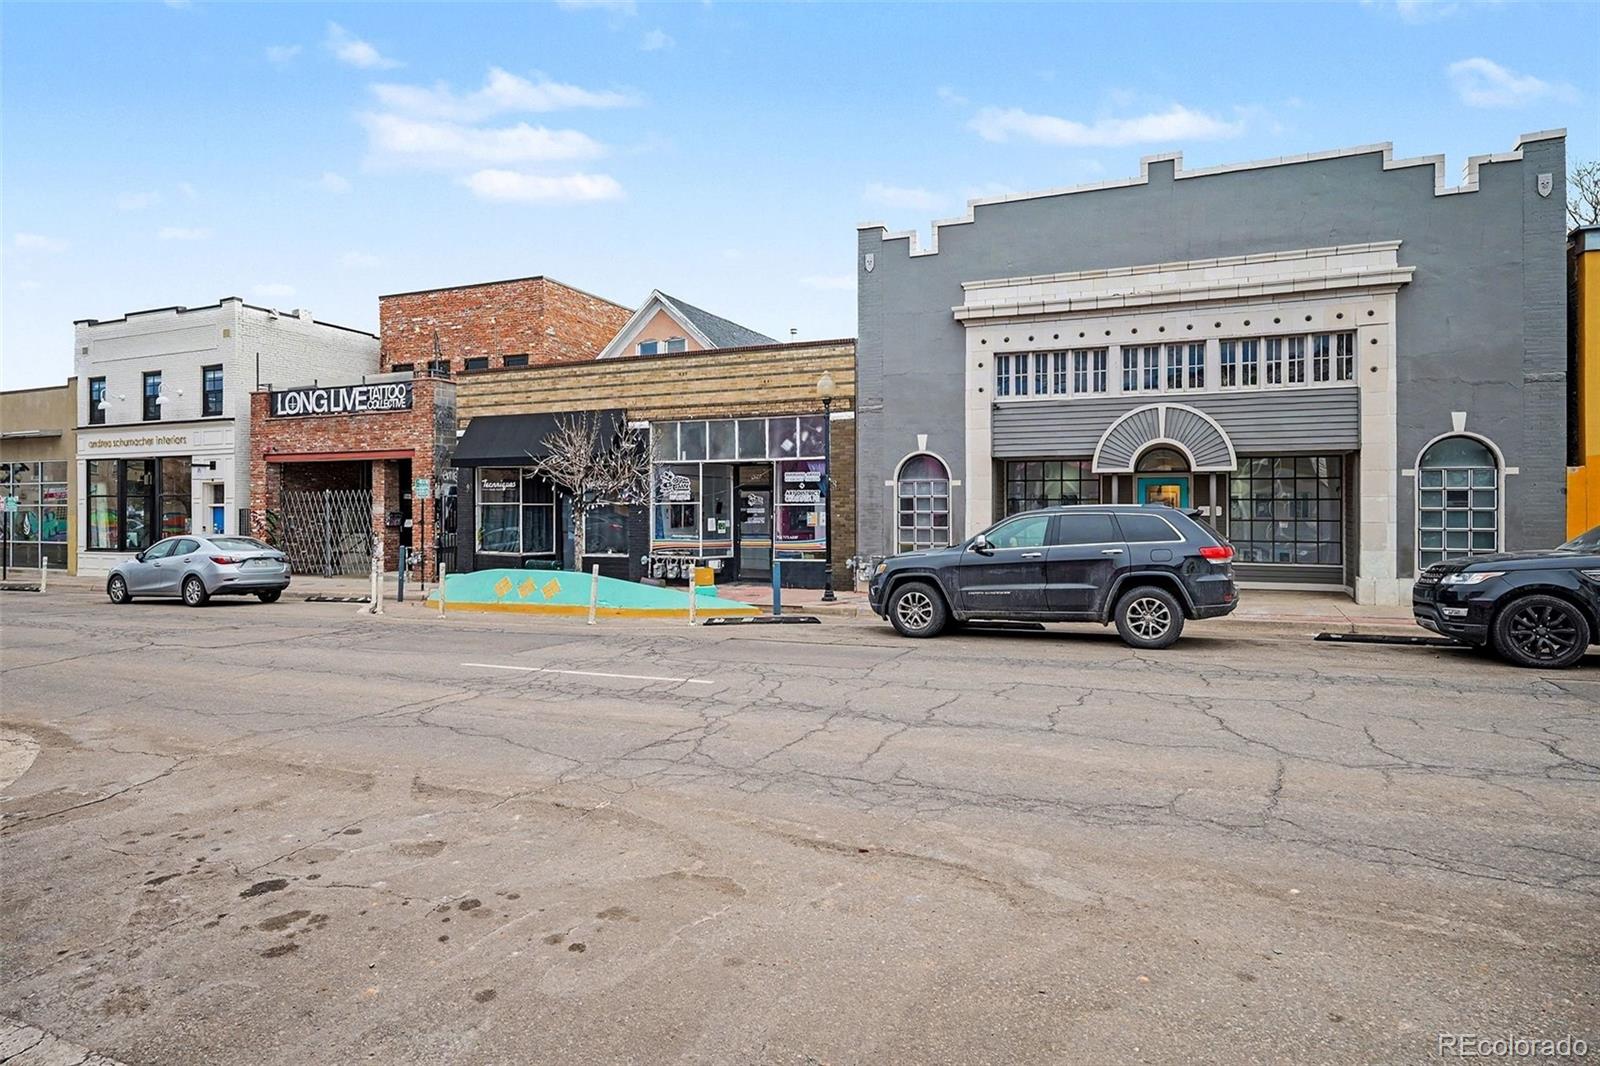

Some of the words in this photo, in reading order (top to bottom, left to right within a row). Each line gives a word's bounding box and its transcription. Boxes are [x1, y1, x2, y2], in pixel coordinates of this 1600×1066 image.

[367, 384, 406, 400] TATTOO
[277, 389, 328, 416] LONG
[330, 386, 368, 412] LIVE
[366, 398, 406, 410] COLLECTIVE
[88, 438, 112, 449] andrea
[113, 436, 154, 448] schumacher
[155, 435, 187, 446] interiors
